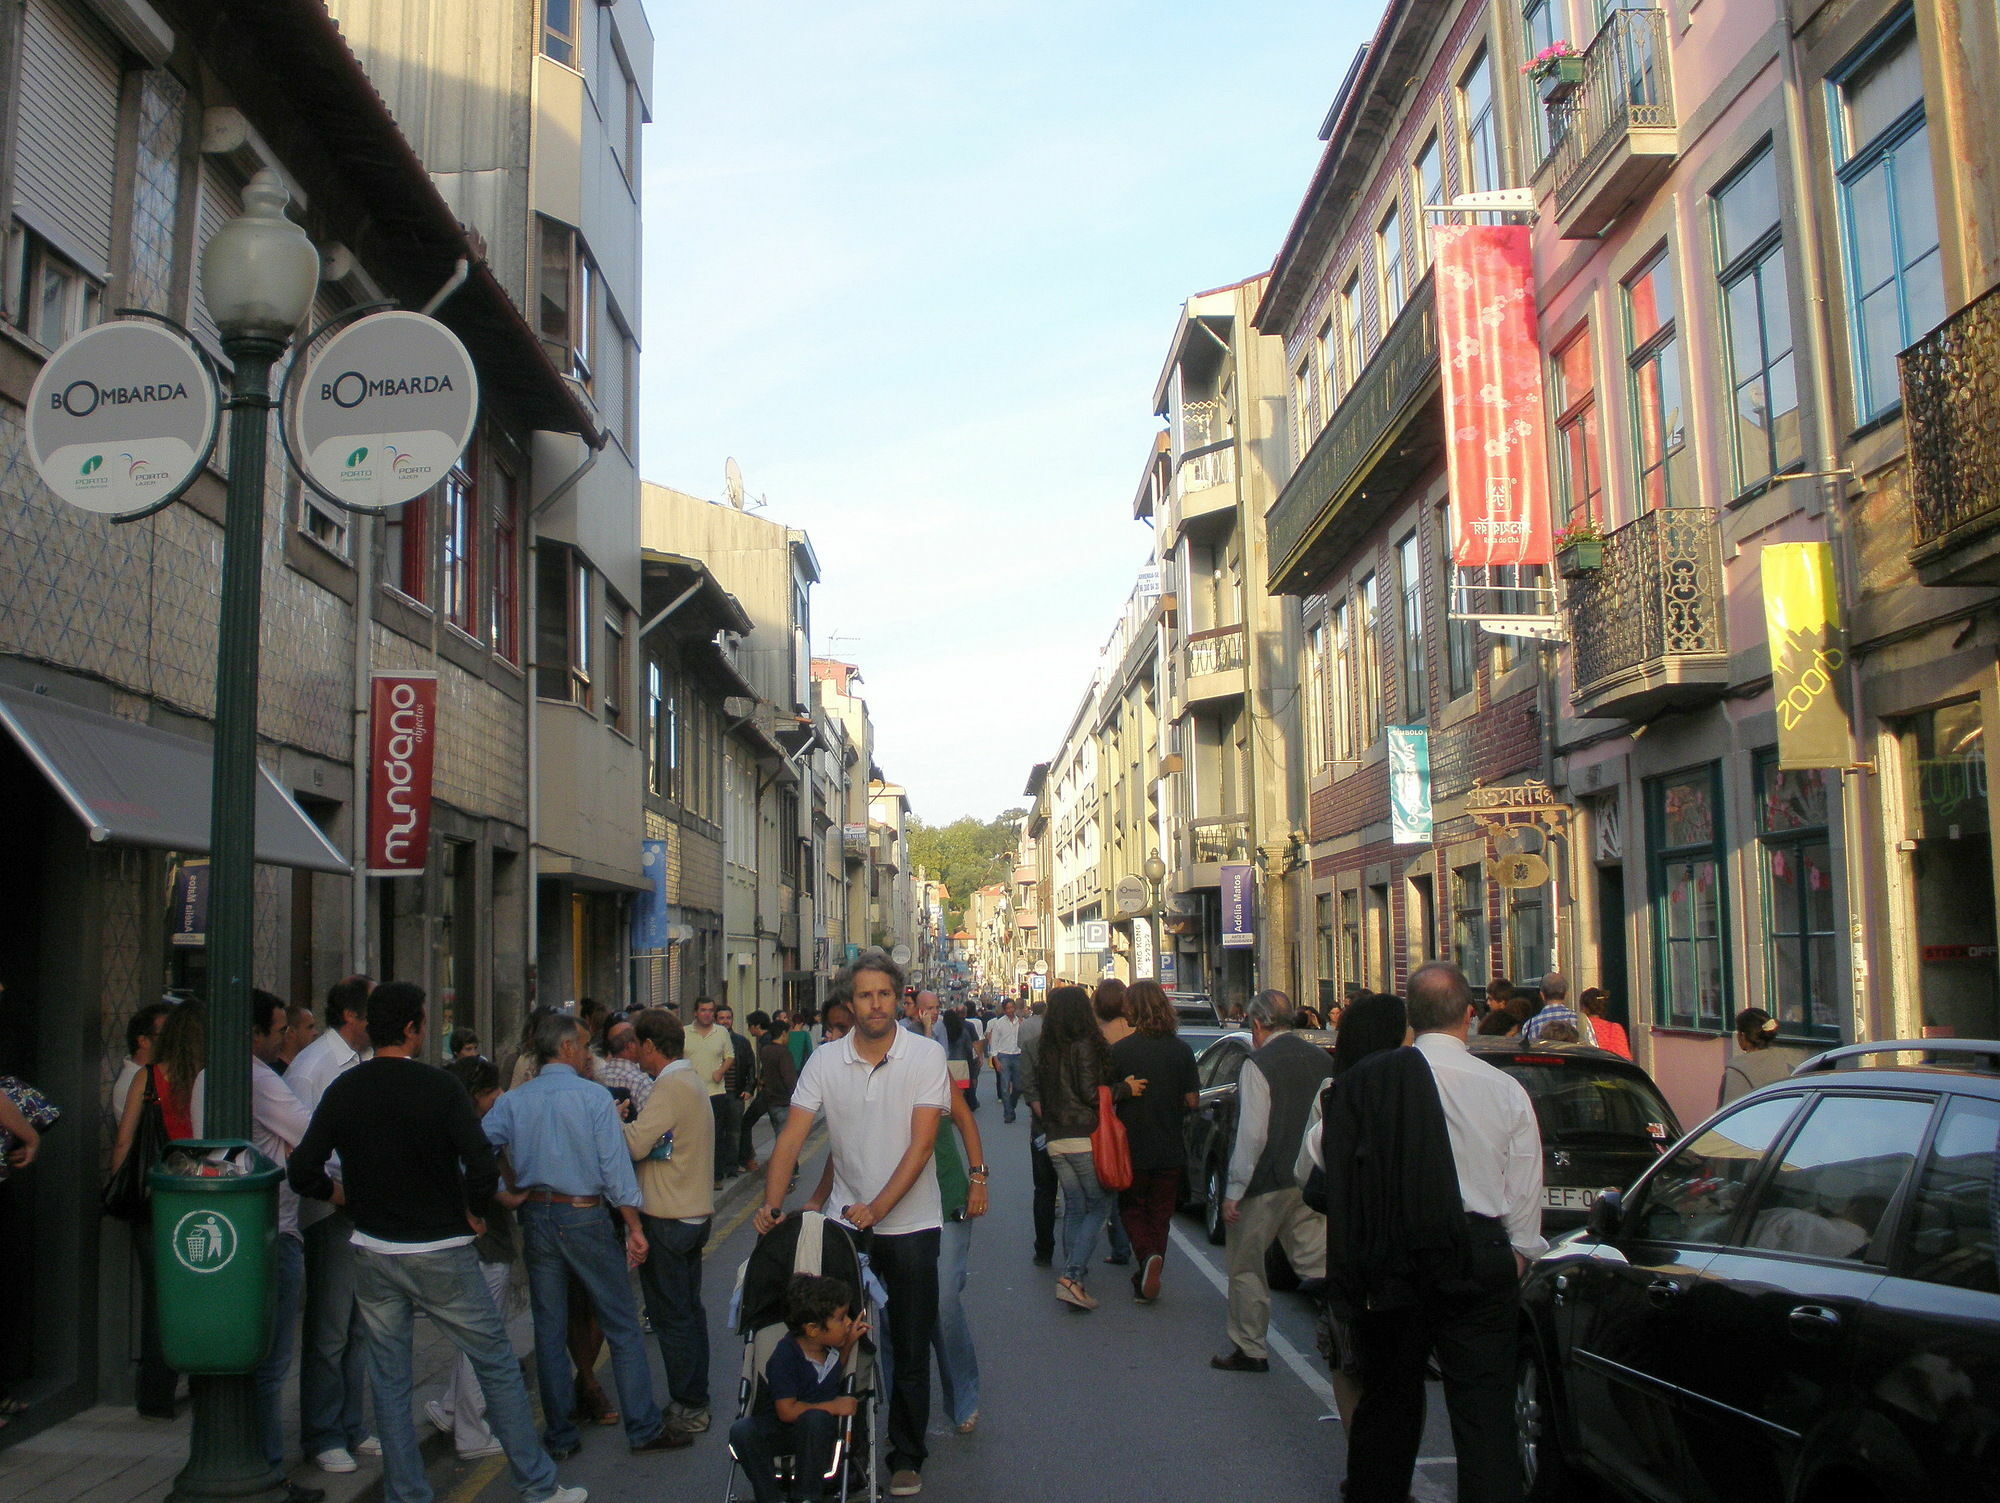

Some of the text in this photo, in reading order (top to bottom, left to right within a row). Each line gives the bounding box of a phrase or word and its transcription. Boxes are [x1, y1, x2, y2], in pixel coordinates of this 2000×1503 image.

[51, 380, 188, 417] BOMBARDA
[321, 371, 453, 408] BOMBARDA
[135, 472, 168, 480] PORTO
[398, 466, 431, 474] PORTO
[414, 703, 427, 743] objectos
[384, 684, 417, 864] mundano
[1233, 874, 1242, 932] Adélia Matos
